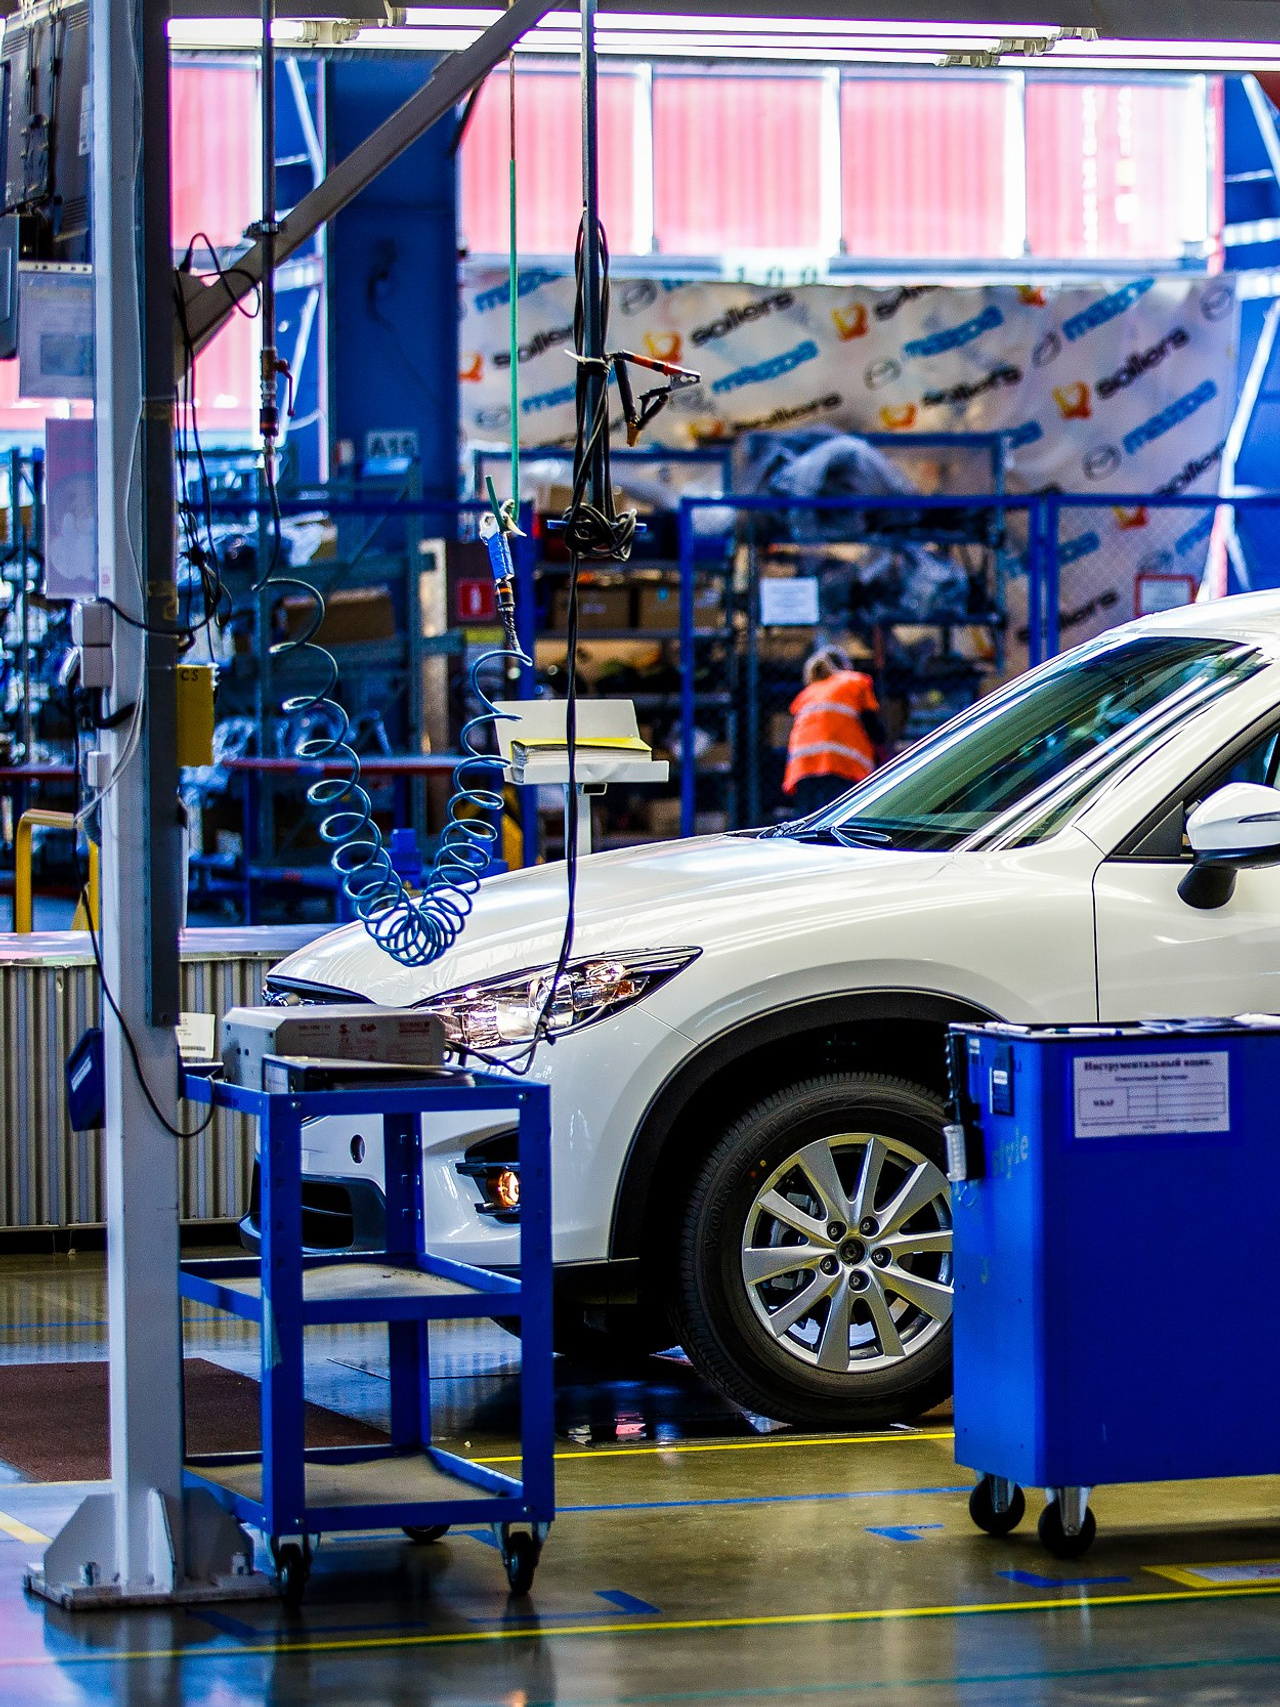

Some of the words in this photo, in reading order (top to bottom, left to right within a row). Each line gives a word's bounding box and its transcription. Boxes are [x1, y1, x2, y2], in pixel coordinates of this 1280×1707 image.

[493, 323, 575, 370] soller
[690, 291, 795, 347] sollers
[711, 340, 820, 395] mazda
[1095, 325, 1191, 400] sollers
[1122, 379, 1218, 453] mazda
[1083, 1058, 1182, 1072] Инструментальный
